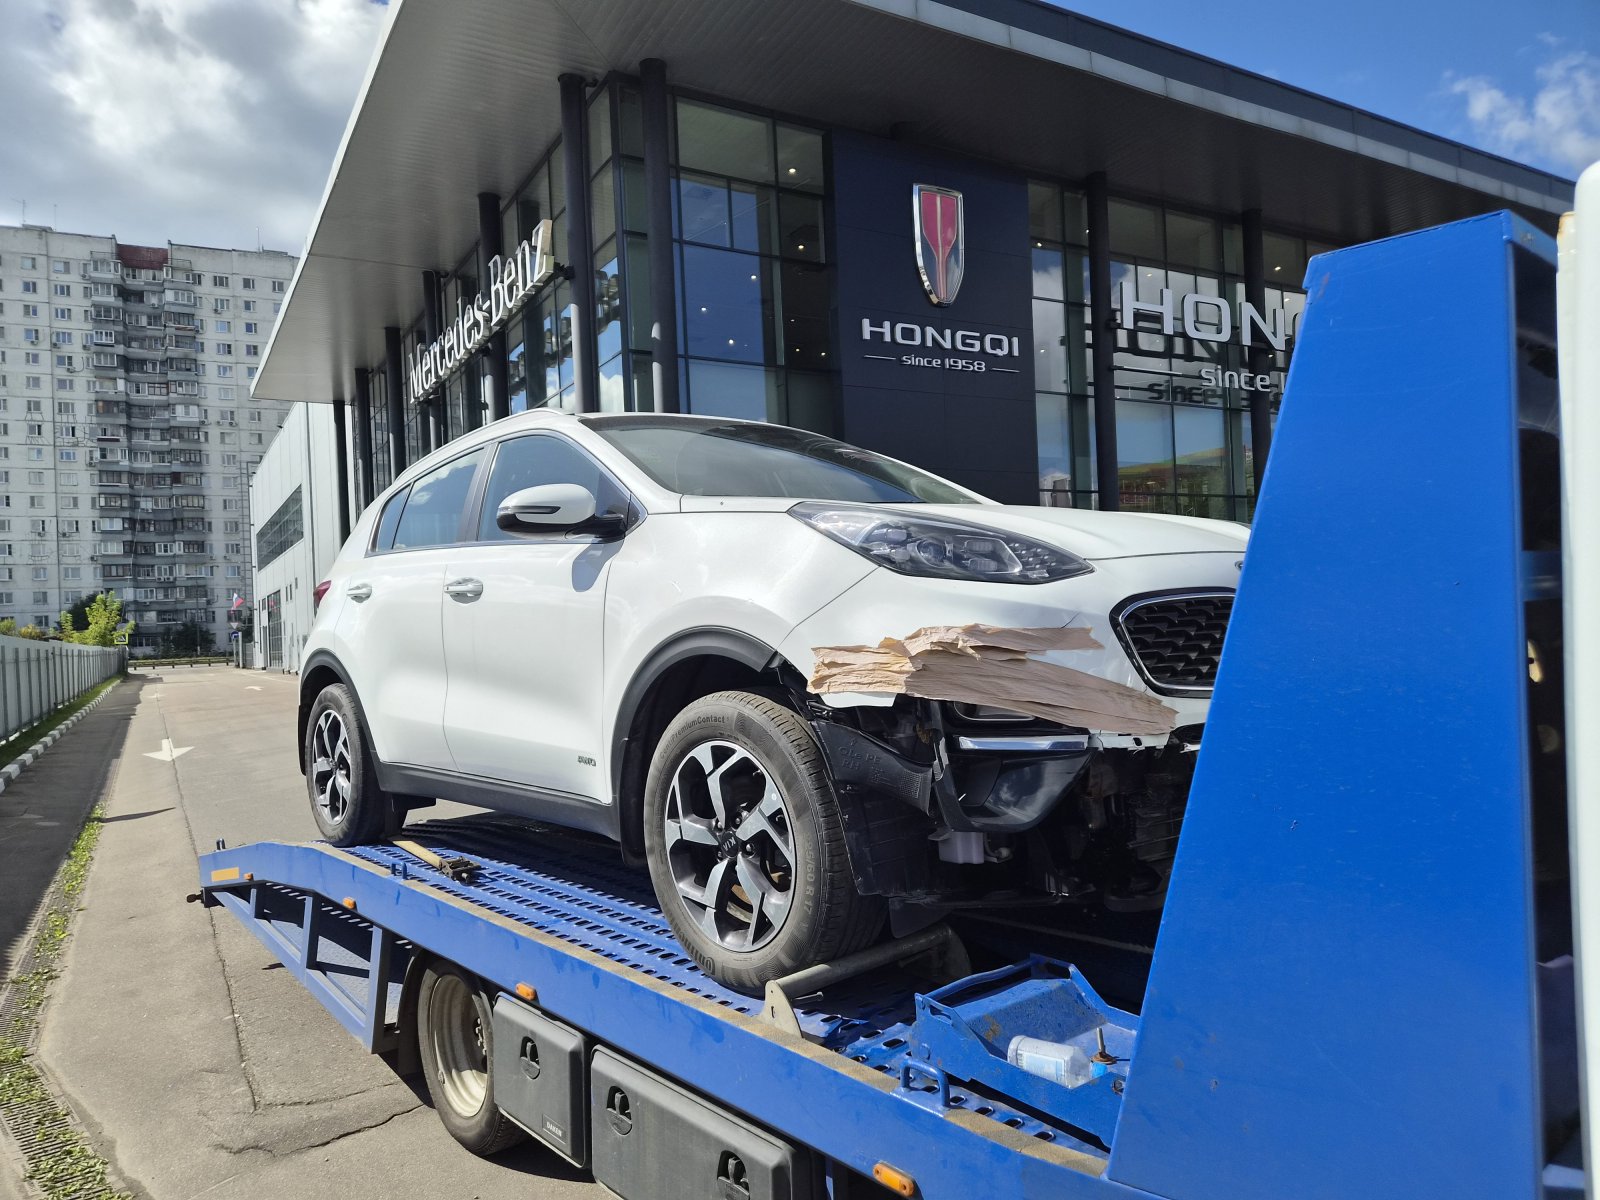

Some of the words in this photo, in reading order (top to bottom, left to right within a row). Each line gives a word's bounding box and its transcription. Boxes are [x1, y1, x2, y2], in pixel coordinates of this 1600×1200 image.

[408, 219, 554, 404] Mercedes-Benz
[1120, 281, 1304, 351] HON
[861, 317, 1020, 357] HONGQI
[901, 354, 942, 368] since
[944, 357, 986, 372] 1958
[1201, 365, 1271, 392] since
